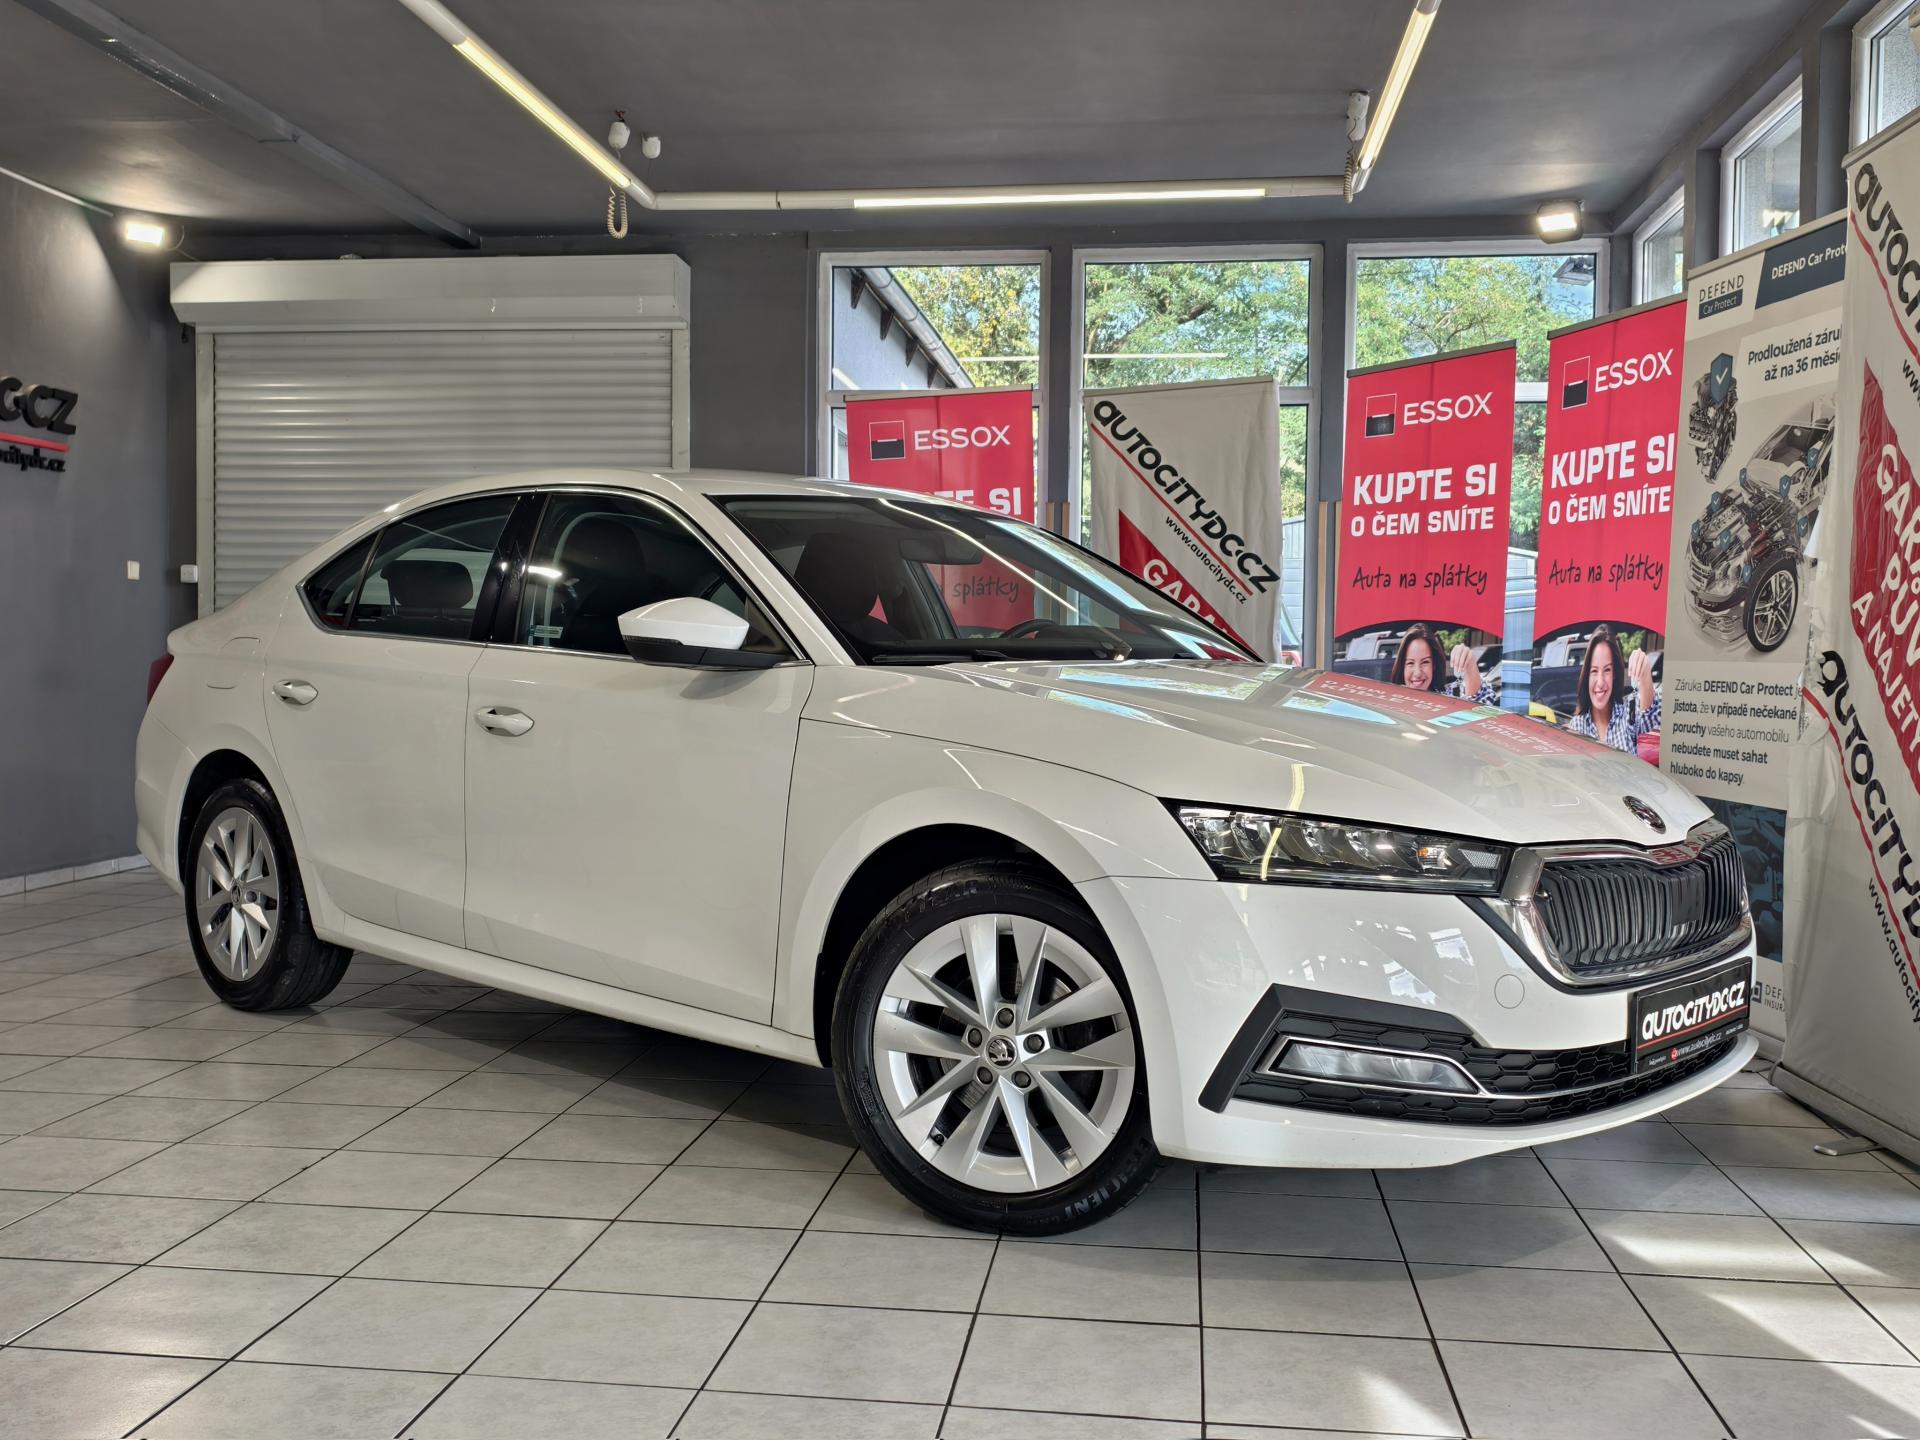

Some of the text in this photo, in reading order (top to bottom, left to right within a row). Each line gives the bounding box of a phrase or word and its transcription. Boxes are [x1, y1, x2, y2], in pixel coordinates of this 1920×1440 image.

[1772, 258, 1806, 280] DEFEND
[1807, 251, 1823, 266] Car
[1699, 274, 1744, 303] DEFEND
[1702, 295, 1737, 315] Car Protect
[1748, 332, 1812, 365] Prodloužená
[1594, 348, 1674, 393] ESSOX
[1764, 366, 1777, 381] až
[1780, 365, 1794, 378] na
[1795, 358, 1808, 374] 36
[1403, 391, 1493, 426] ESSOX
[914, 424, 1011, 450] ESSOX
[1550, 432, 1675, 489] KUPTE SI
[1353, 462, 1497, 506] KUPTE SI
[988, 487, 1022, 516] SI
[1548, 483, 1672, 526] O ČEM SNÍTE
[1351, 504, 1495, 537] O ČEM SNÍTE
[1165, 515, 1246, 605] www.autocitydc.cz
[1549, 553, 1664, 592] Auta na splátky
[953, 576, 1019, 604] splátky
[1352, 563, 1488, 596] Auta na splátky
[1675, 679, 1702, 692] Záruka
[1703, 680, 1738, 694] DEFEND
[1740, 682, 1755, 695] Car
[1757, 682, 1793, 697] Protect
[1673, 699, 1797, 720] jistota, že v případě nečekané
[1673, 722, 1789, 743] poruchy vašeho automobilu
[1671, 742, 1768, 764] nebudete muset sahat
[1670, 761, 1704, 777] hluboko
[1705, 767, 1717, 779] do
[1764, 998, 1786, 1012] INSUR
[1765, 984, 1785, 1001] DEF
